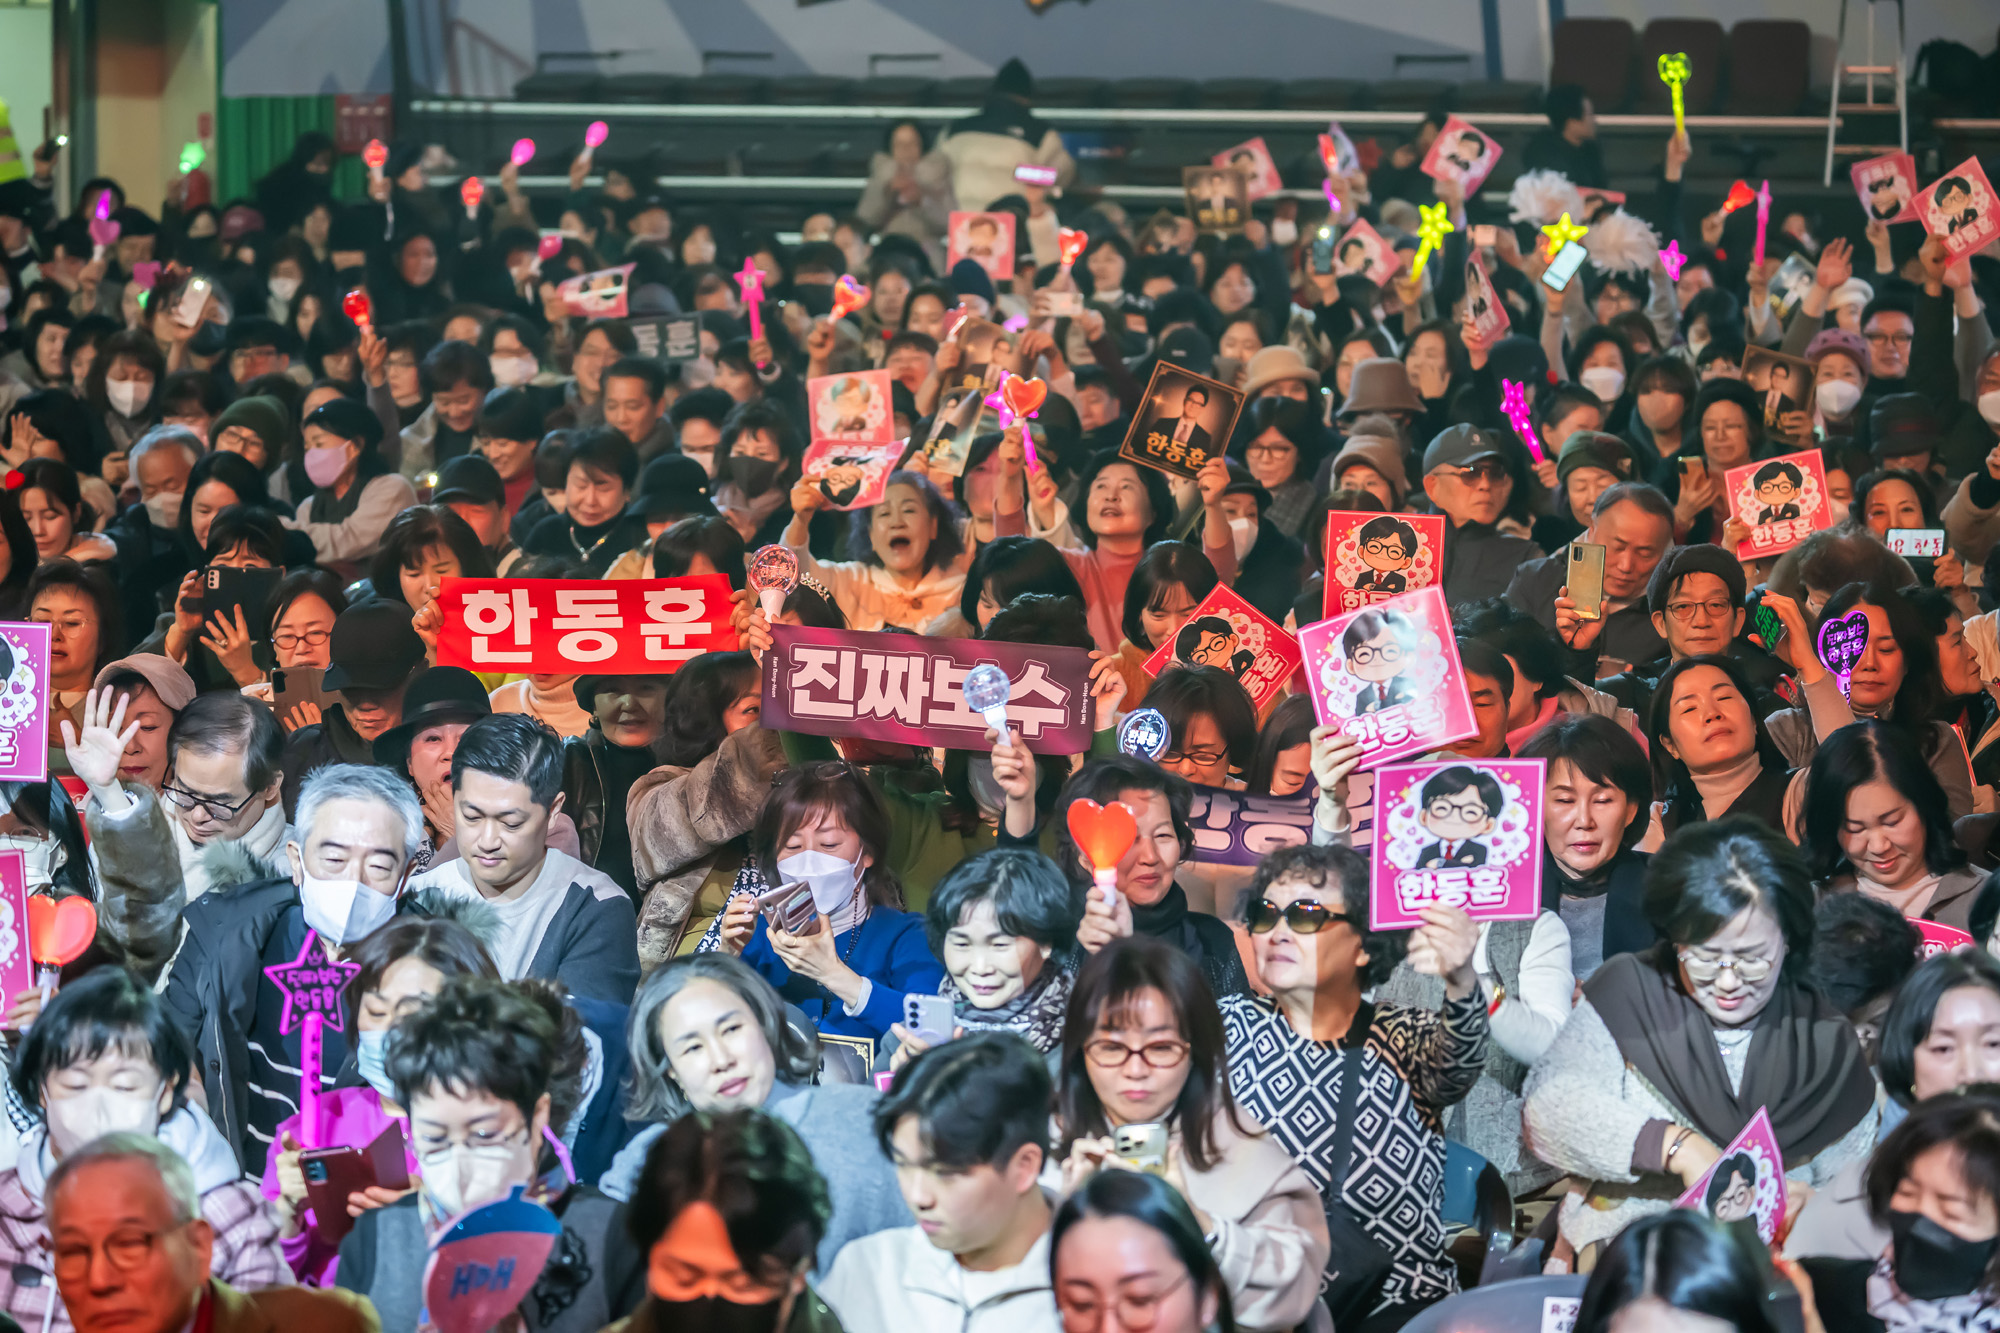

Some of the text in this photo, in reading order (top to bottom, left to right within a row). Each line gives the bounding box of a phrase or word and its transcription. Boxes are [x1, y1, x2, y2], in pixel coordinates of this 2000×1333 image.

[1146, 431, 1207, 471] 한동훈
[1751, 518, 1814, 548] 한동훈
[461, 587, 712, 663] 한동훈
[1826, 622, 1865, 647] 진짜보수
[1827, 637, 1864, 664] 한동훈
[791, 647, 1067, 736] 진짜보수
[1238, 650, 1285, 698] 동훈
[1344, 698, 1442, 752] 한동훈
[1399, 868, 1506, 910] 한동훈
[449, 1256, 517, 1300] HDH
